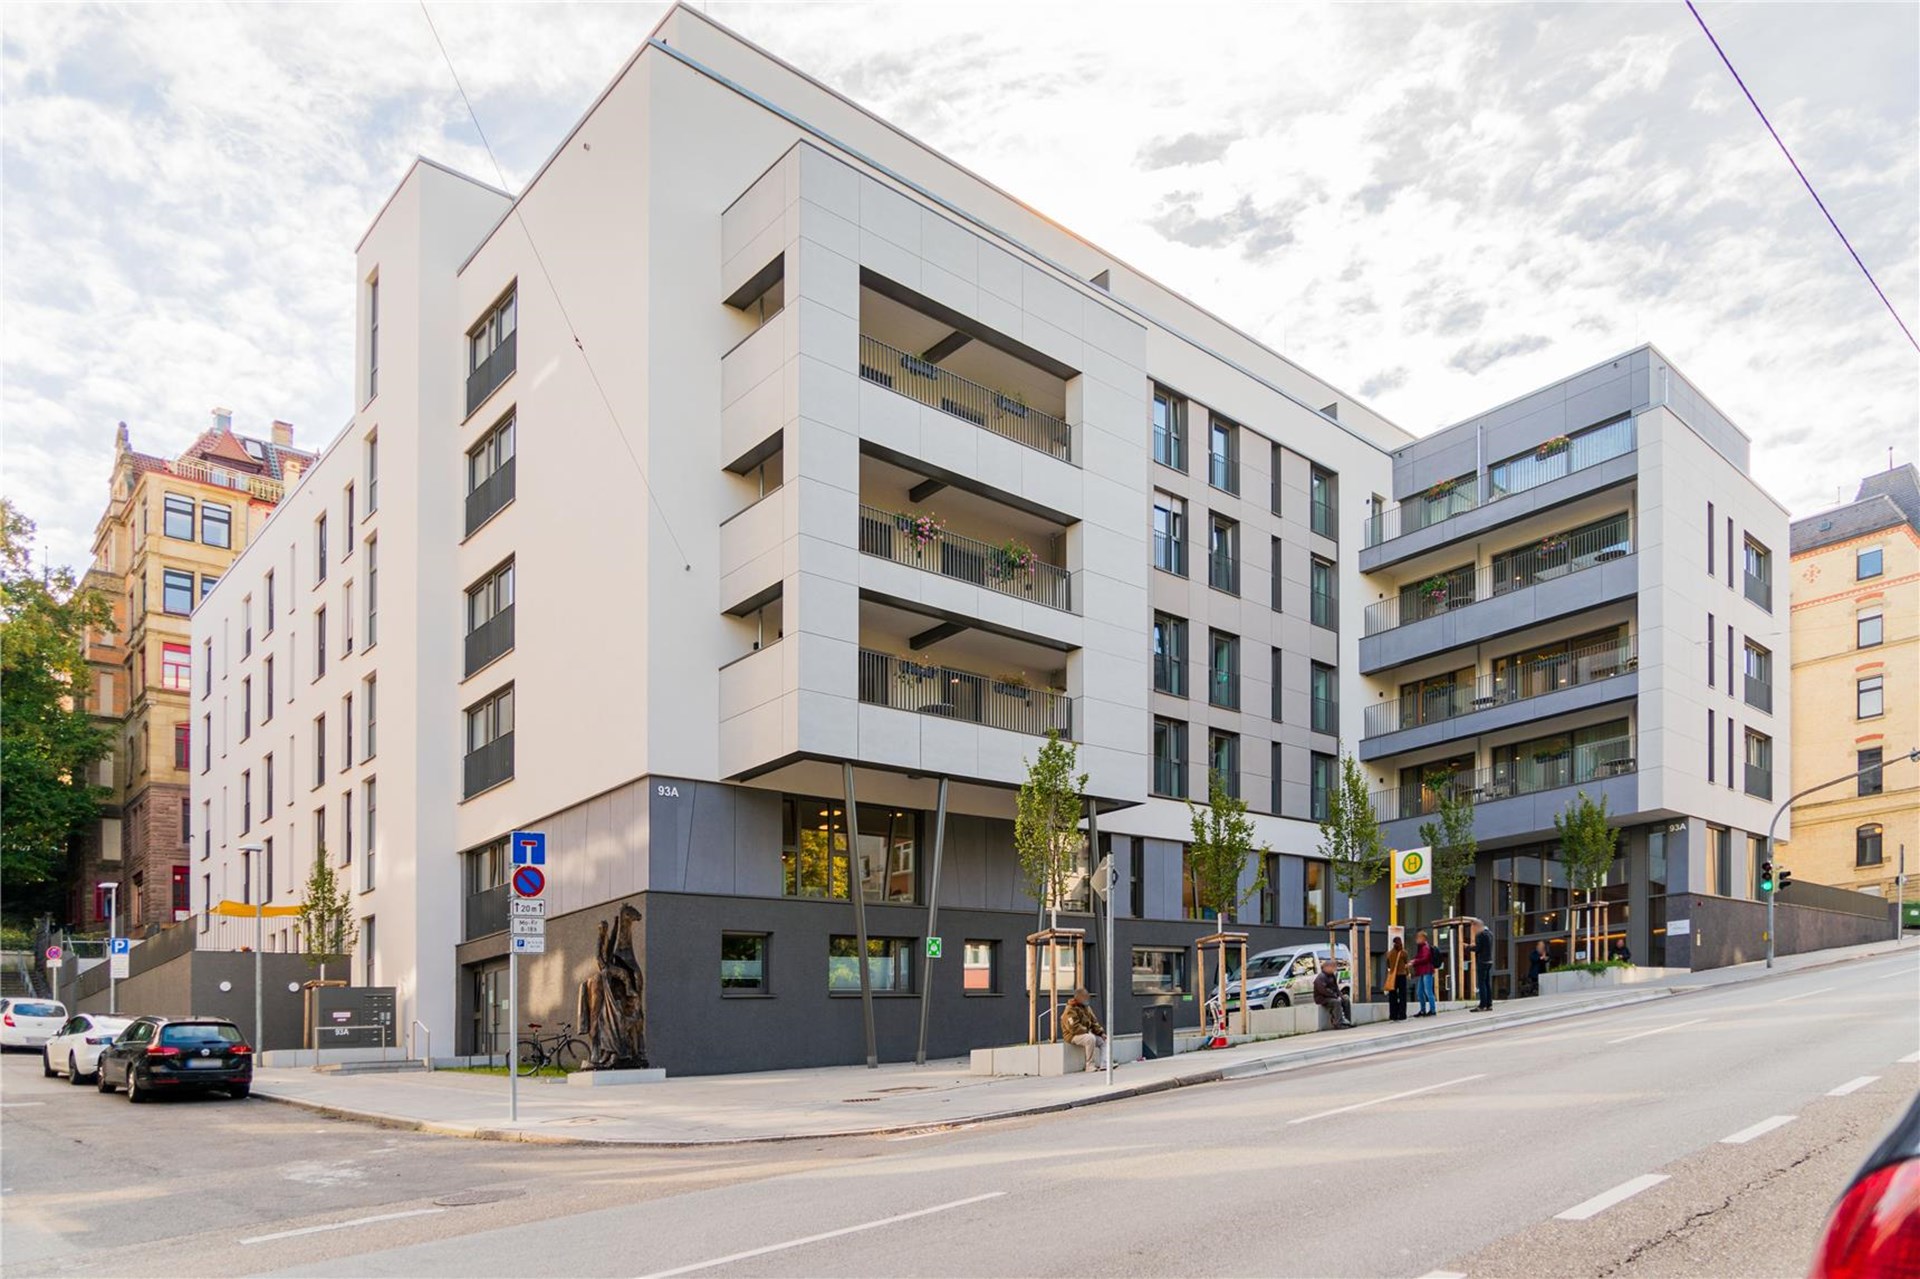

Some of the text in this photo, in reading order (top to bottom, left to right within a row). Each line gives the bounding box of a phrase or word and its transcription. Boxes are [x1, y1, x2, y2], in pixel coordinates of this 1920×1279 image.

[658, 785, 679, 797] 93A
[1669, 822, 1686, 832] 93A
[1407, 856, 1417, 870] H
[115, 940, 125, 953] P
[335, 1028, 349, 1036] 93A
